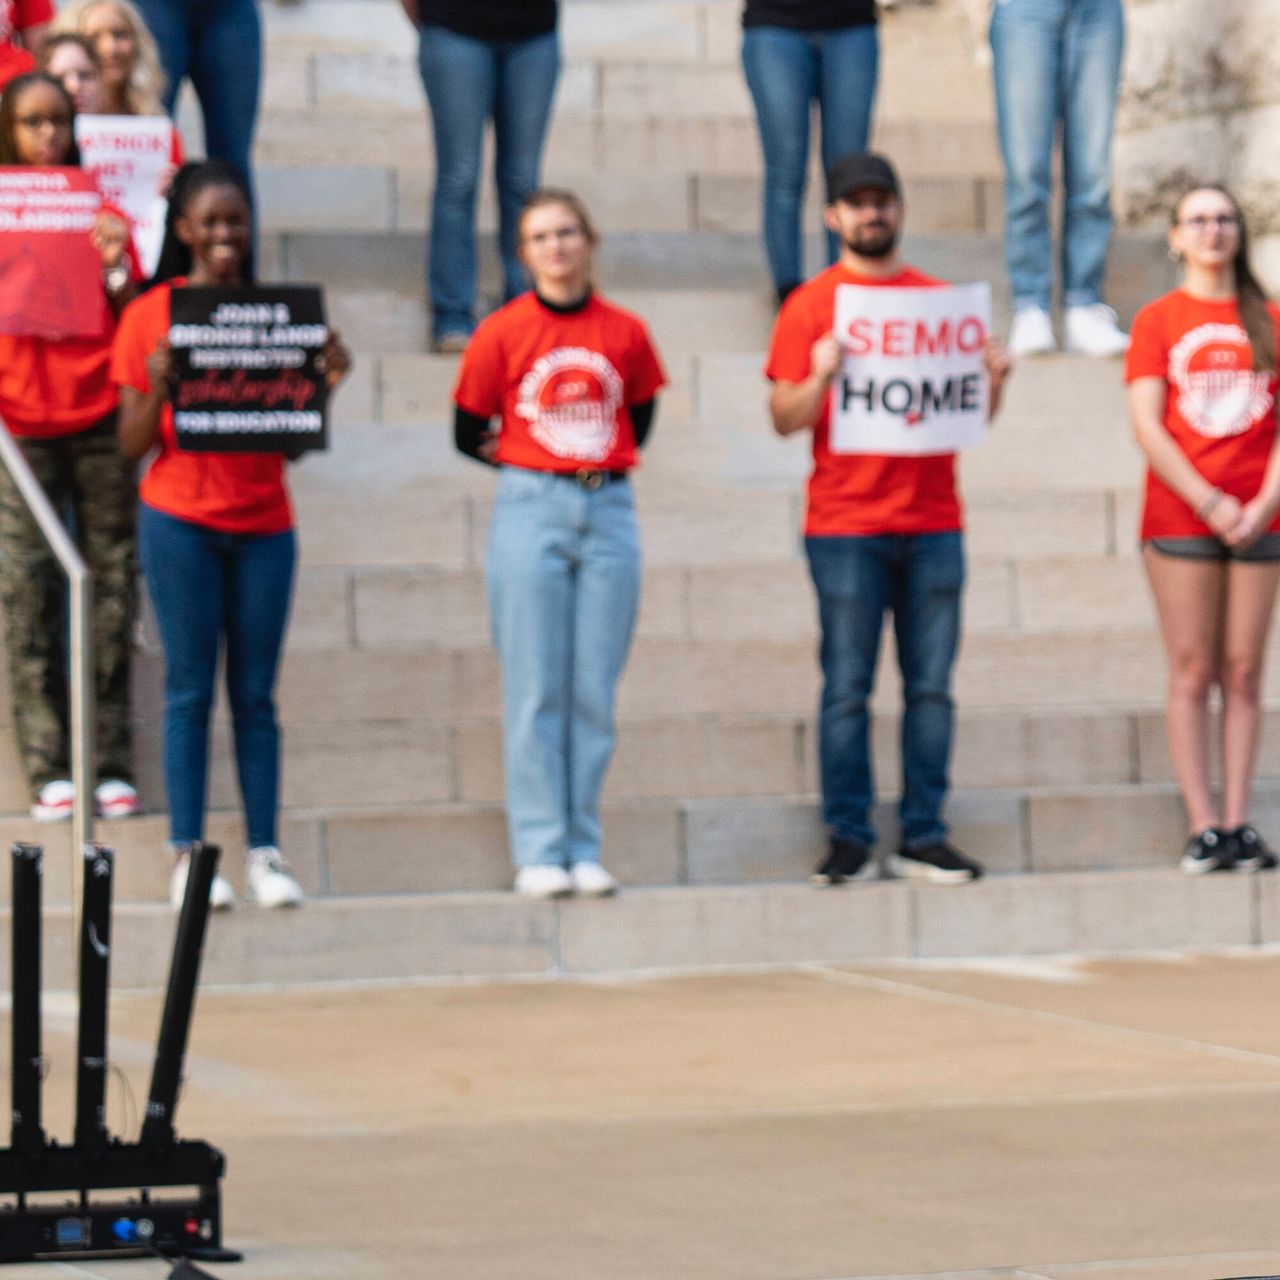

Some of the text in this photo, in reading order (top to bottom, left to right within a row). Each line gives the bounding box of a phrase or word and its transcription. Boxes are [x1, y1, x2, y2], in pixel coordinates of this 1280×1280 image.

[847, 314, 985, 357] SEMO
[178, 368, 315, 410] scholarship
[842, 373, 980, 416] HOME
[175, 411, 322, 433] FOR EDUCATION
